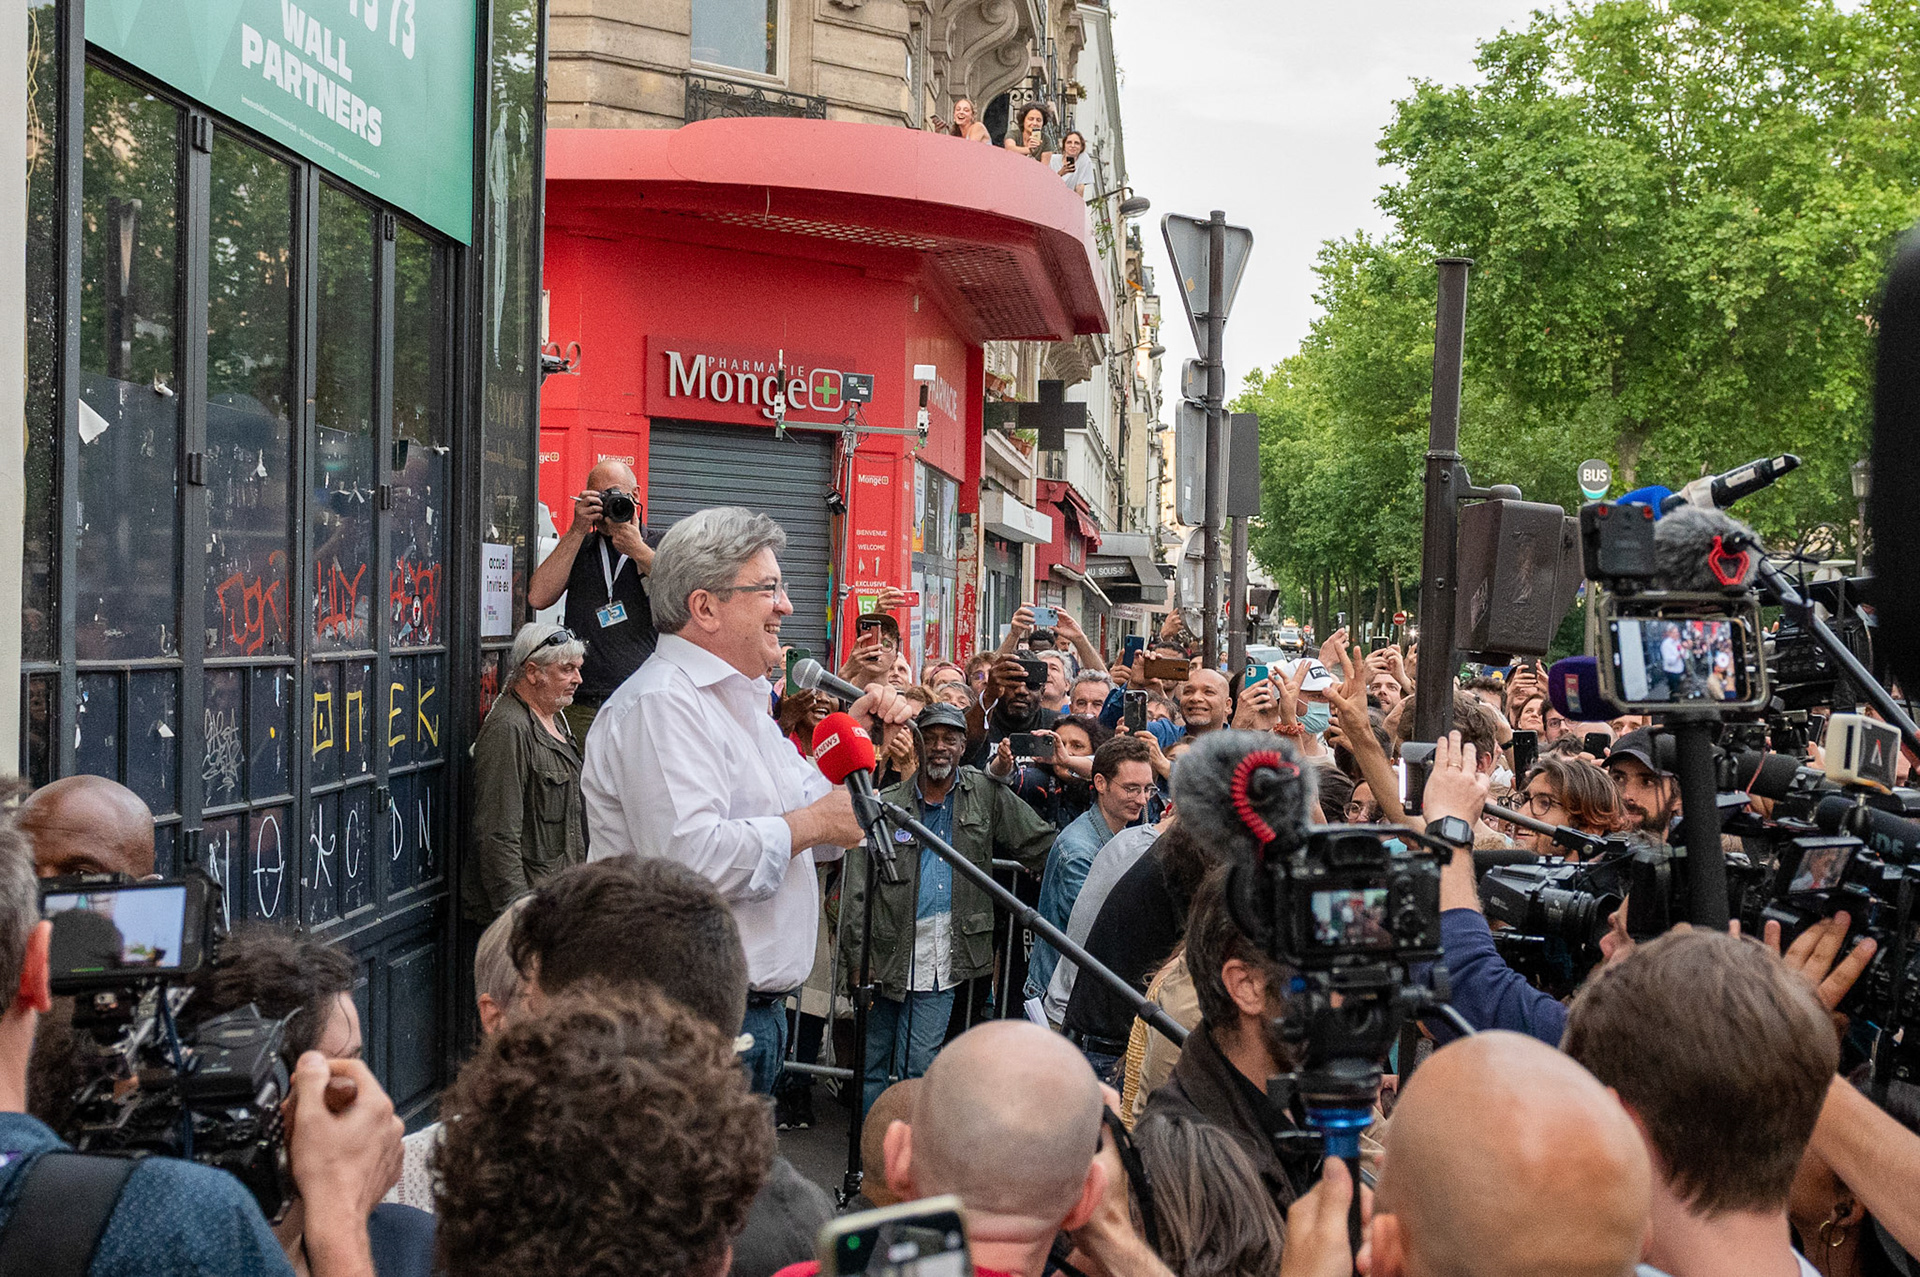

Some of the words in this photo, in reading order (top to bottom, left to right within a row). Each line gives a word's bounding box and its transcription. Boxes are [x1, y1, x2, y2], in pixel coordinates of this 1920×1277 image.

[281, 0, 352, 83] WALL
[242, 23, 382, 147] PARTNERS
[665, 351, 807, 418] Monge
[858, 474, 881, 487] Monge
[1583, 469, 1607, 482] BUS
[1114, 604, 1143, 613] BAGAGES
[1113, 611, 1143, 620] LUGGAGE
[1312, 668, 1327, 677] PIN
